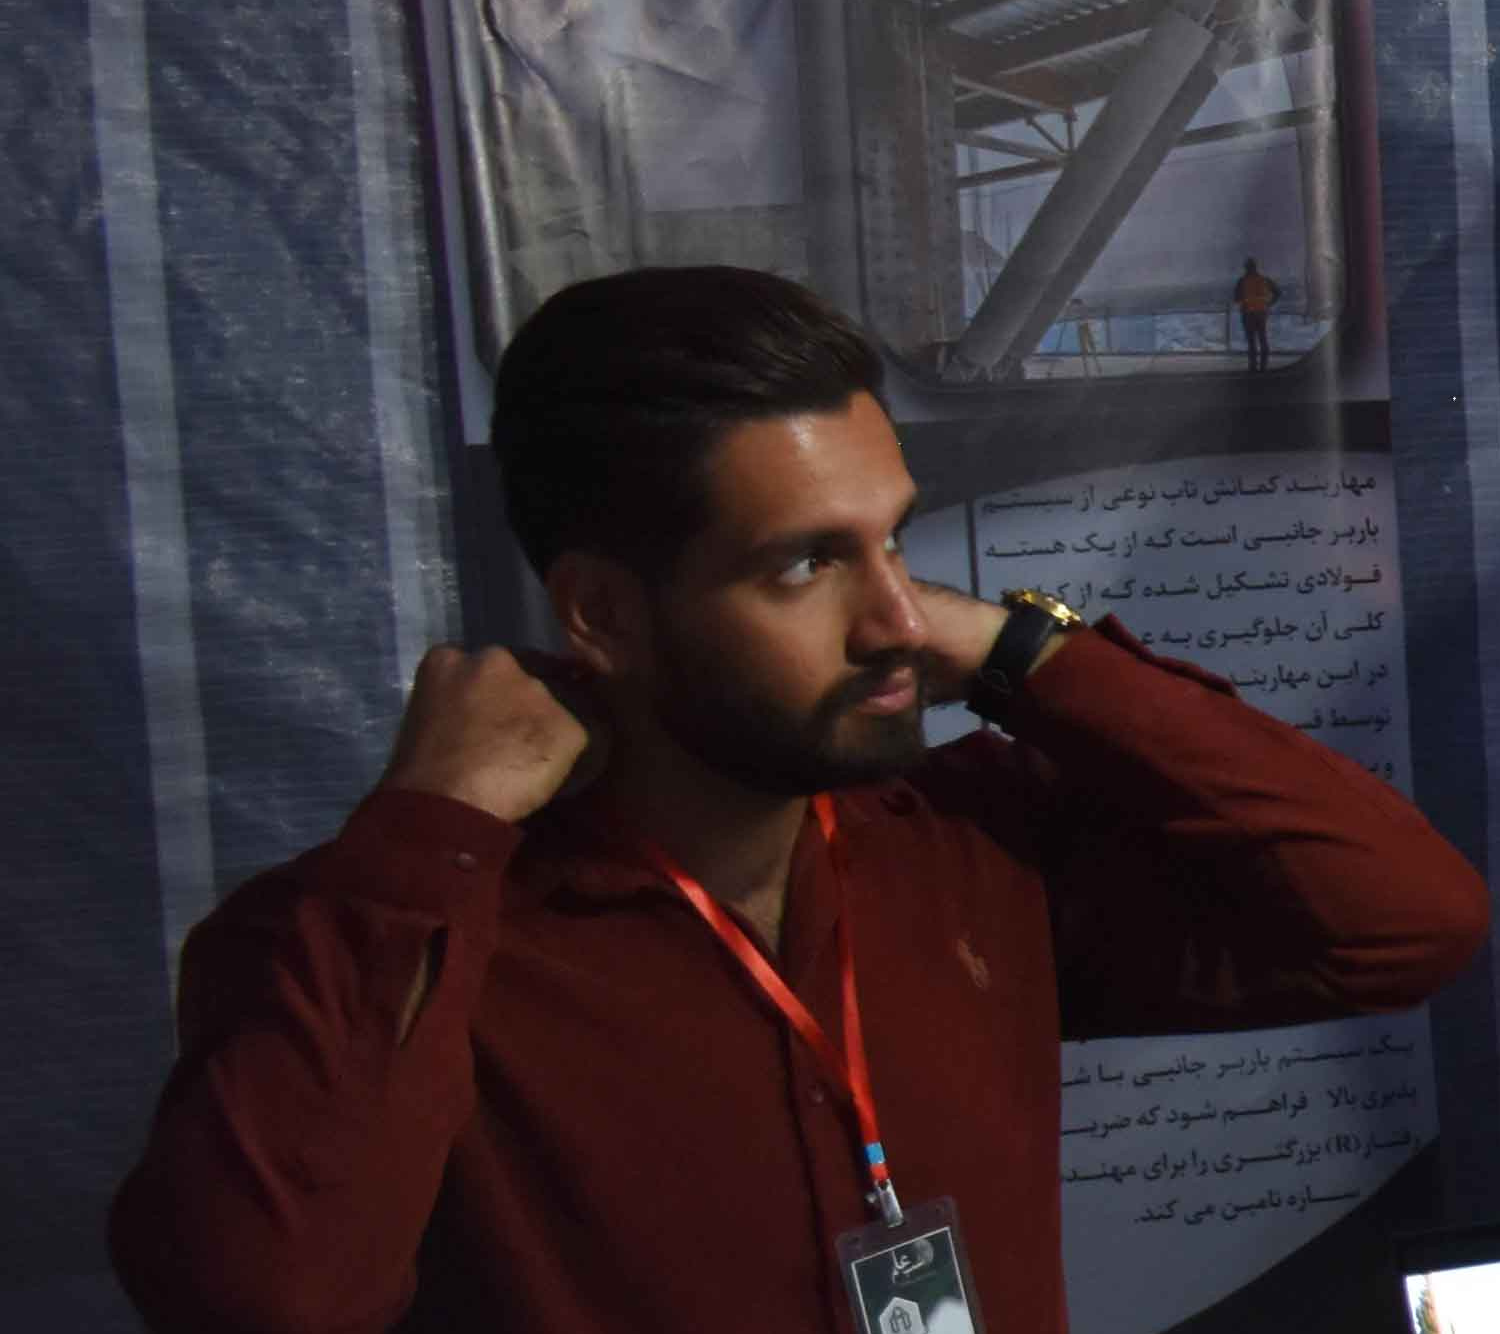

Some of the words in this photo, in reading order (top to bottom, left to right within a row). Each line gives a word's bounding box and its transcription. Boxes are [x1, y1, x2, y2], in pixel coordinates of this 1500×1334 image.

[984, 538, 1066, 559] هسته
[1143, 527, 1174, 550] که
[1178, 524, 1239, 548] است
[1100, 574, 1137, 600] که
[1142, 573, 1201, 598] شده
[1206, 570, 1291, 602] تشکیل
[1295, 564, 1383, 596] فولادی
